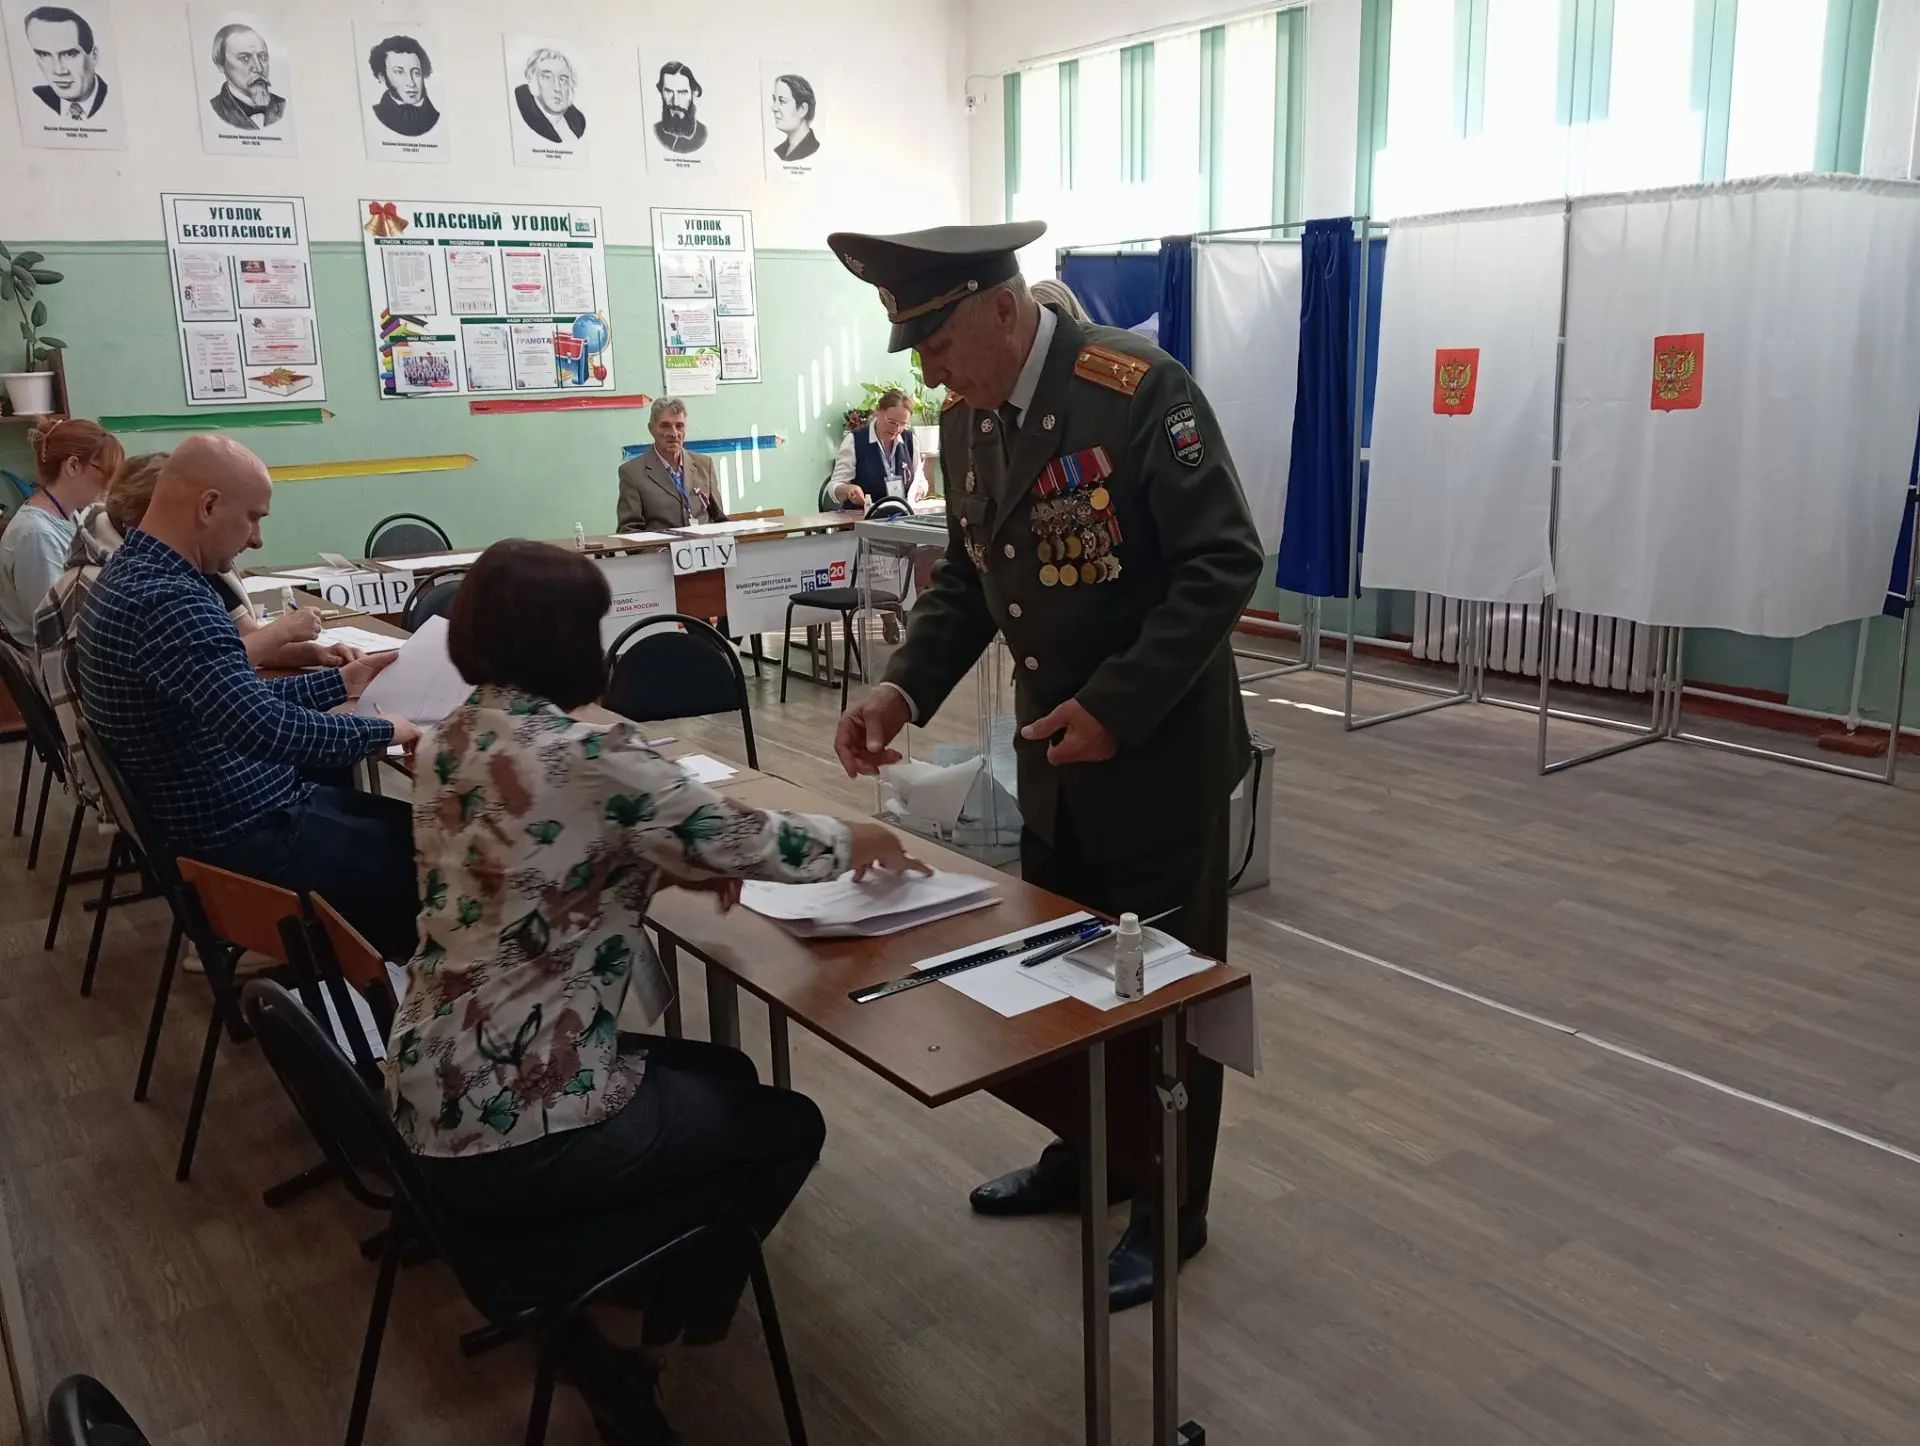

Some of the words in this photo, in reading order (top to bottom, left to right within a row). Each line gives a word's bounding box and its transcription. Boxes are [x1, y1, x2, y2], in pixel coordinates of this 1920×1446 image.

[209, 207, 262, 221] УГОЛОК
[413, 211, 502, 230] КЛАССНЫЙ
[513, 215, 568, 232] УГОЛОК
[684, 219, 722, 231] УГОЛОК
[183, 224, 292, 239] БЕЗОПАСНОСТИ
[677, 234, 731, 247] ЗДОРОВЬЯ
[516, 337, 551, 345] ГРАМОТА
[735, 582, 760, 590] ВЫБОРЫ
[760, 577, 792, 586] ДЕПУТАТОВ
[804, 581, 816, 592] 18
[816, 573, 828, 585] 19
[830, 565, 844, 578] 20
